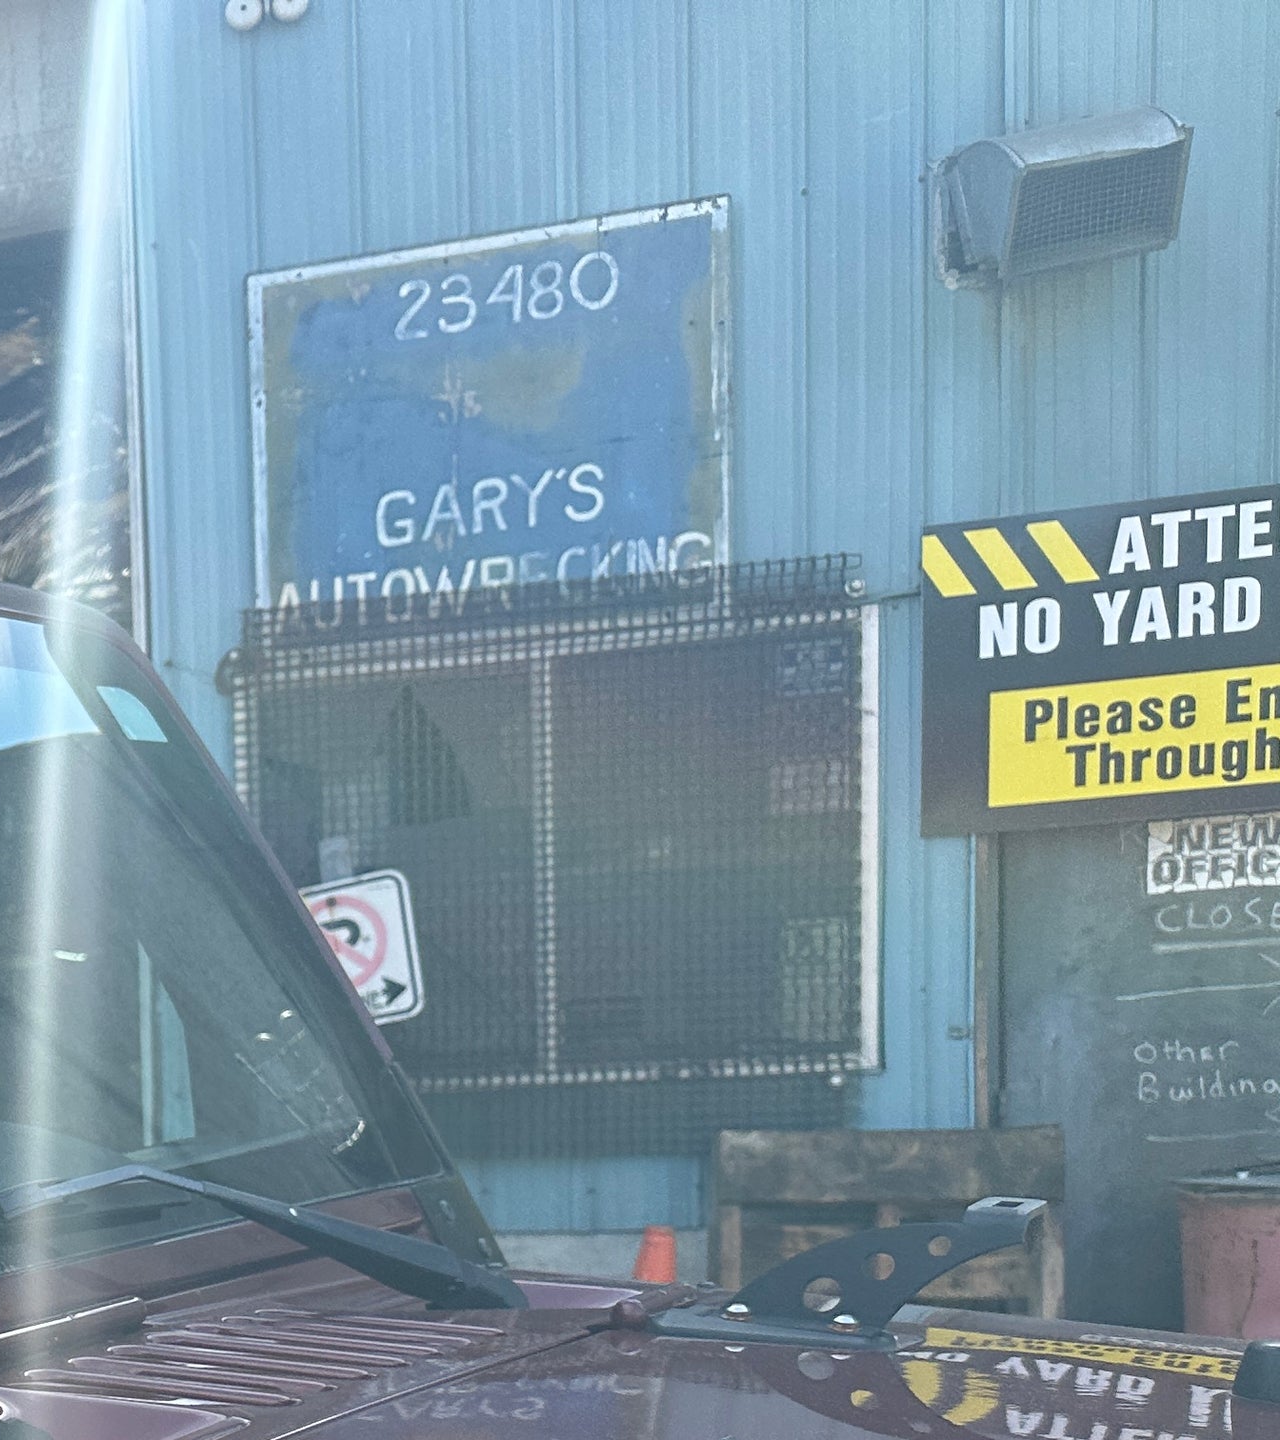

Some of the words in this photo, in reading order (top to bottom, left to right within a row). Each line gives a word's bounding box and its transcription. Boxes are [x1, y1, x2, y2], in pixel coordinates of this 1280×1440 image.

[393, 251, 619, 341] 23480
[375, 463, 605, 547] GARY'S
[1108, 500, 1273, 575] ATTE
[978, 598, 1061, 659] NO
[1093, 576, 1262, 647] YARD
[1024, 692, 1197, 744] Please
[1065, 727, 1280, 783] Through
[1173, 816, 1280, 856] NEW
